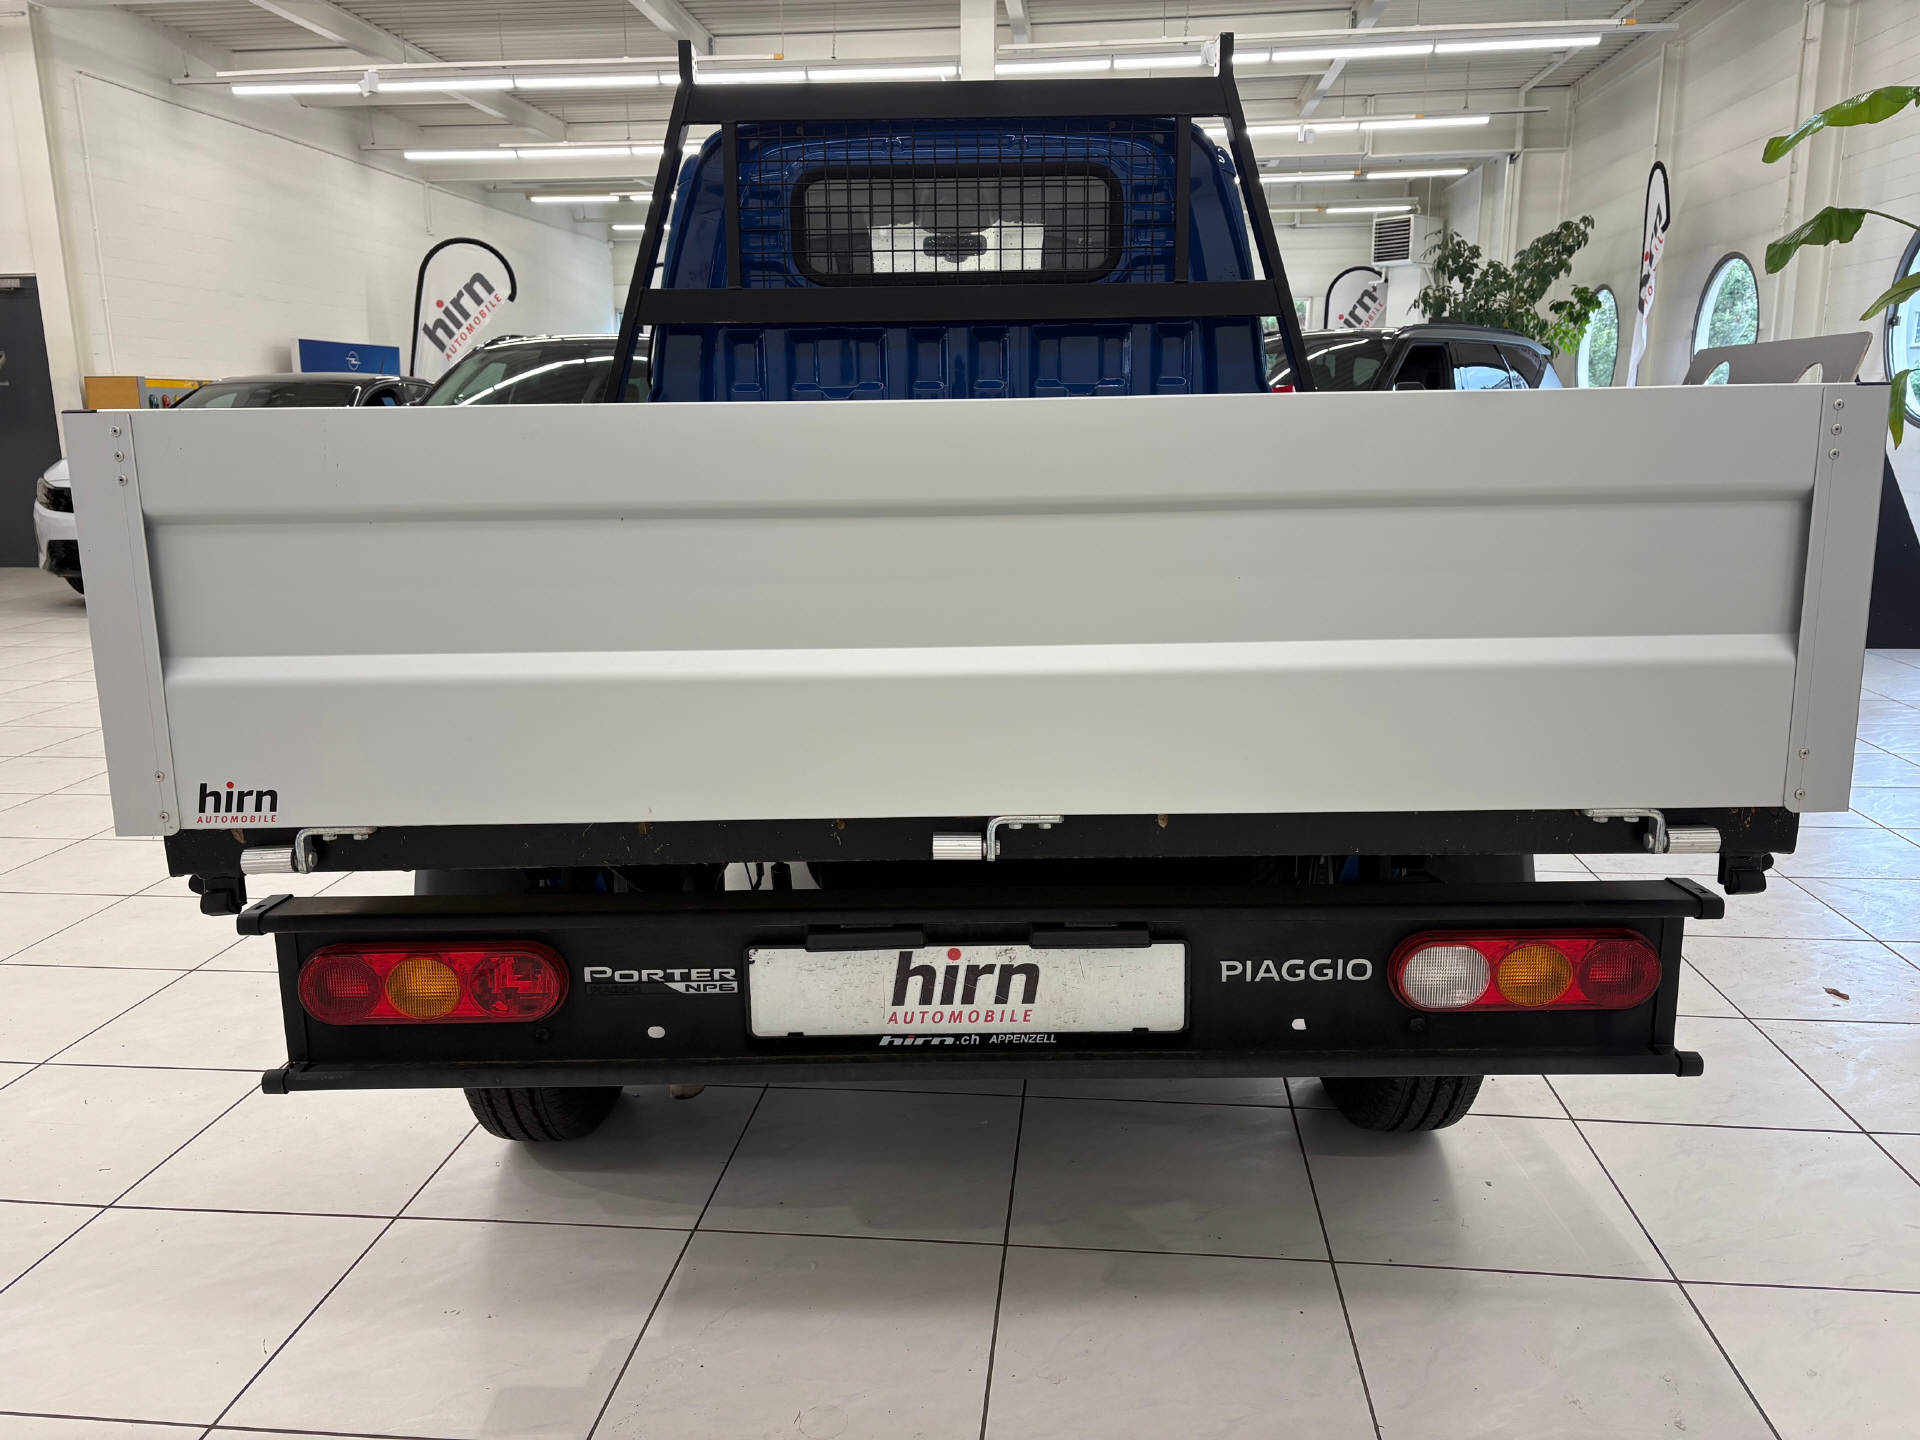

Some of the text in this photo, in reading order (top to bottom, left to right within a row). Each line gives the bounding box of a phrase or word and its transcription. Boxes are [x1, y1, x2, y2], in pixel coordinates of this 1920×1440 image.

[422, 272, 495, 353] hirn
[1337, 289, 1379, 329] irn
[445, 293, 502, 361] AUTOMOBILE
[198, 781, 278, 813] hirn
[196, 815, 277, 824] AUTOMOBILE
[891, 947, 1040, 1006] hirn
[1219, 958, 1373, 982] PIAGGIO
[887, 1009, 1033, 1025] AUTOMOBILE
[988, 1034, 1057, 1044] APPENZELL
